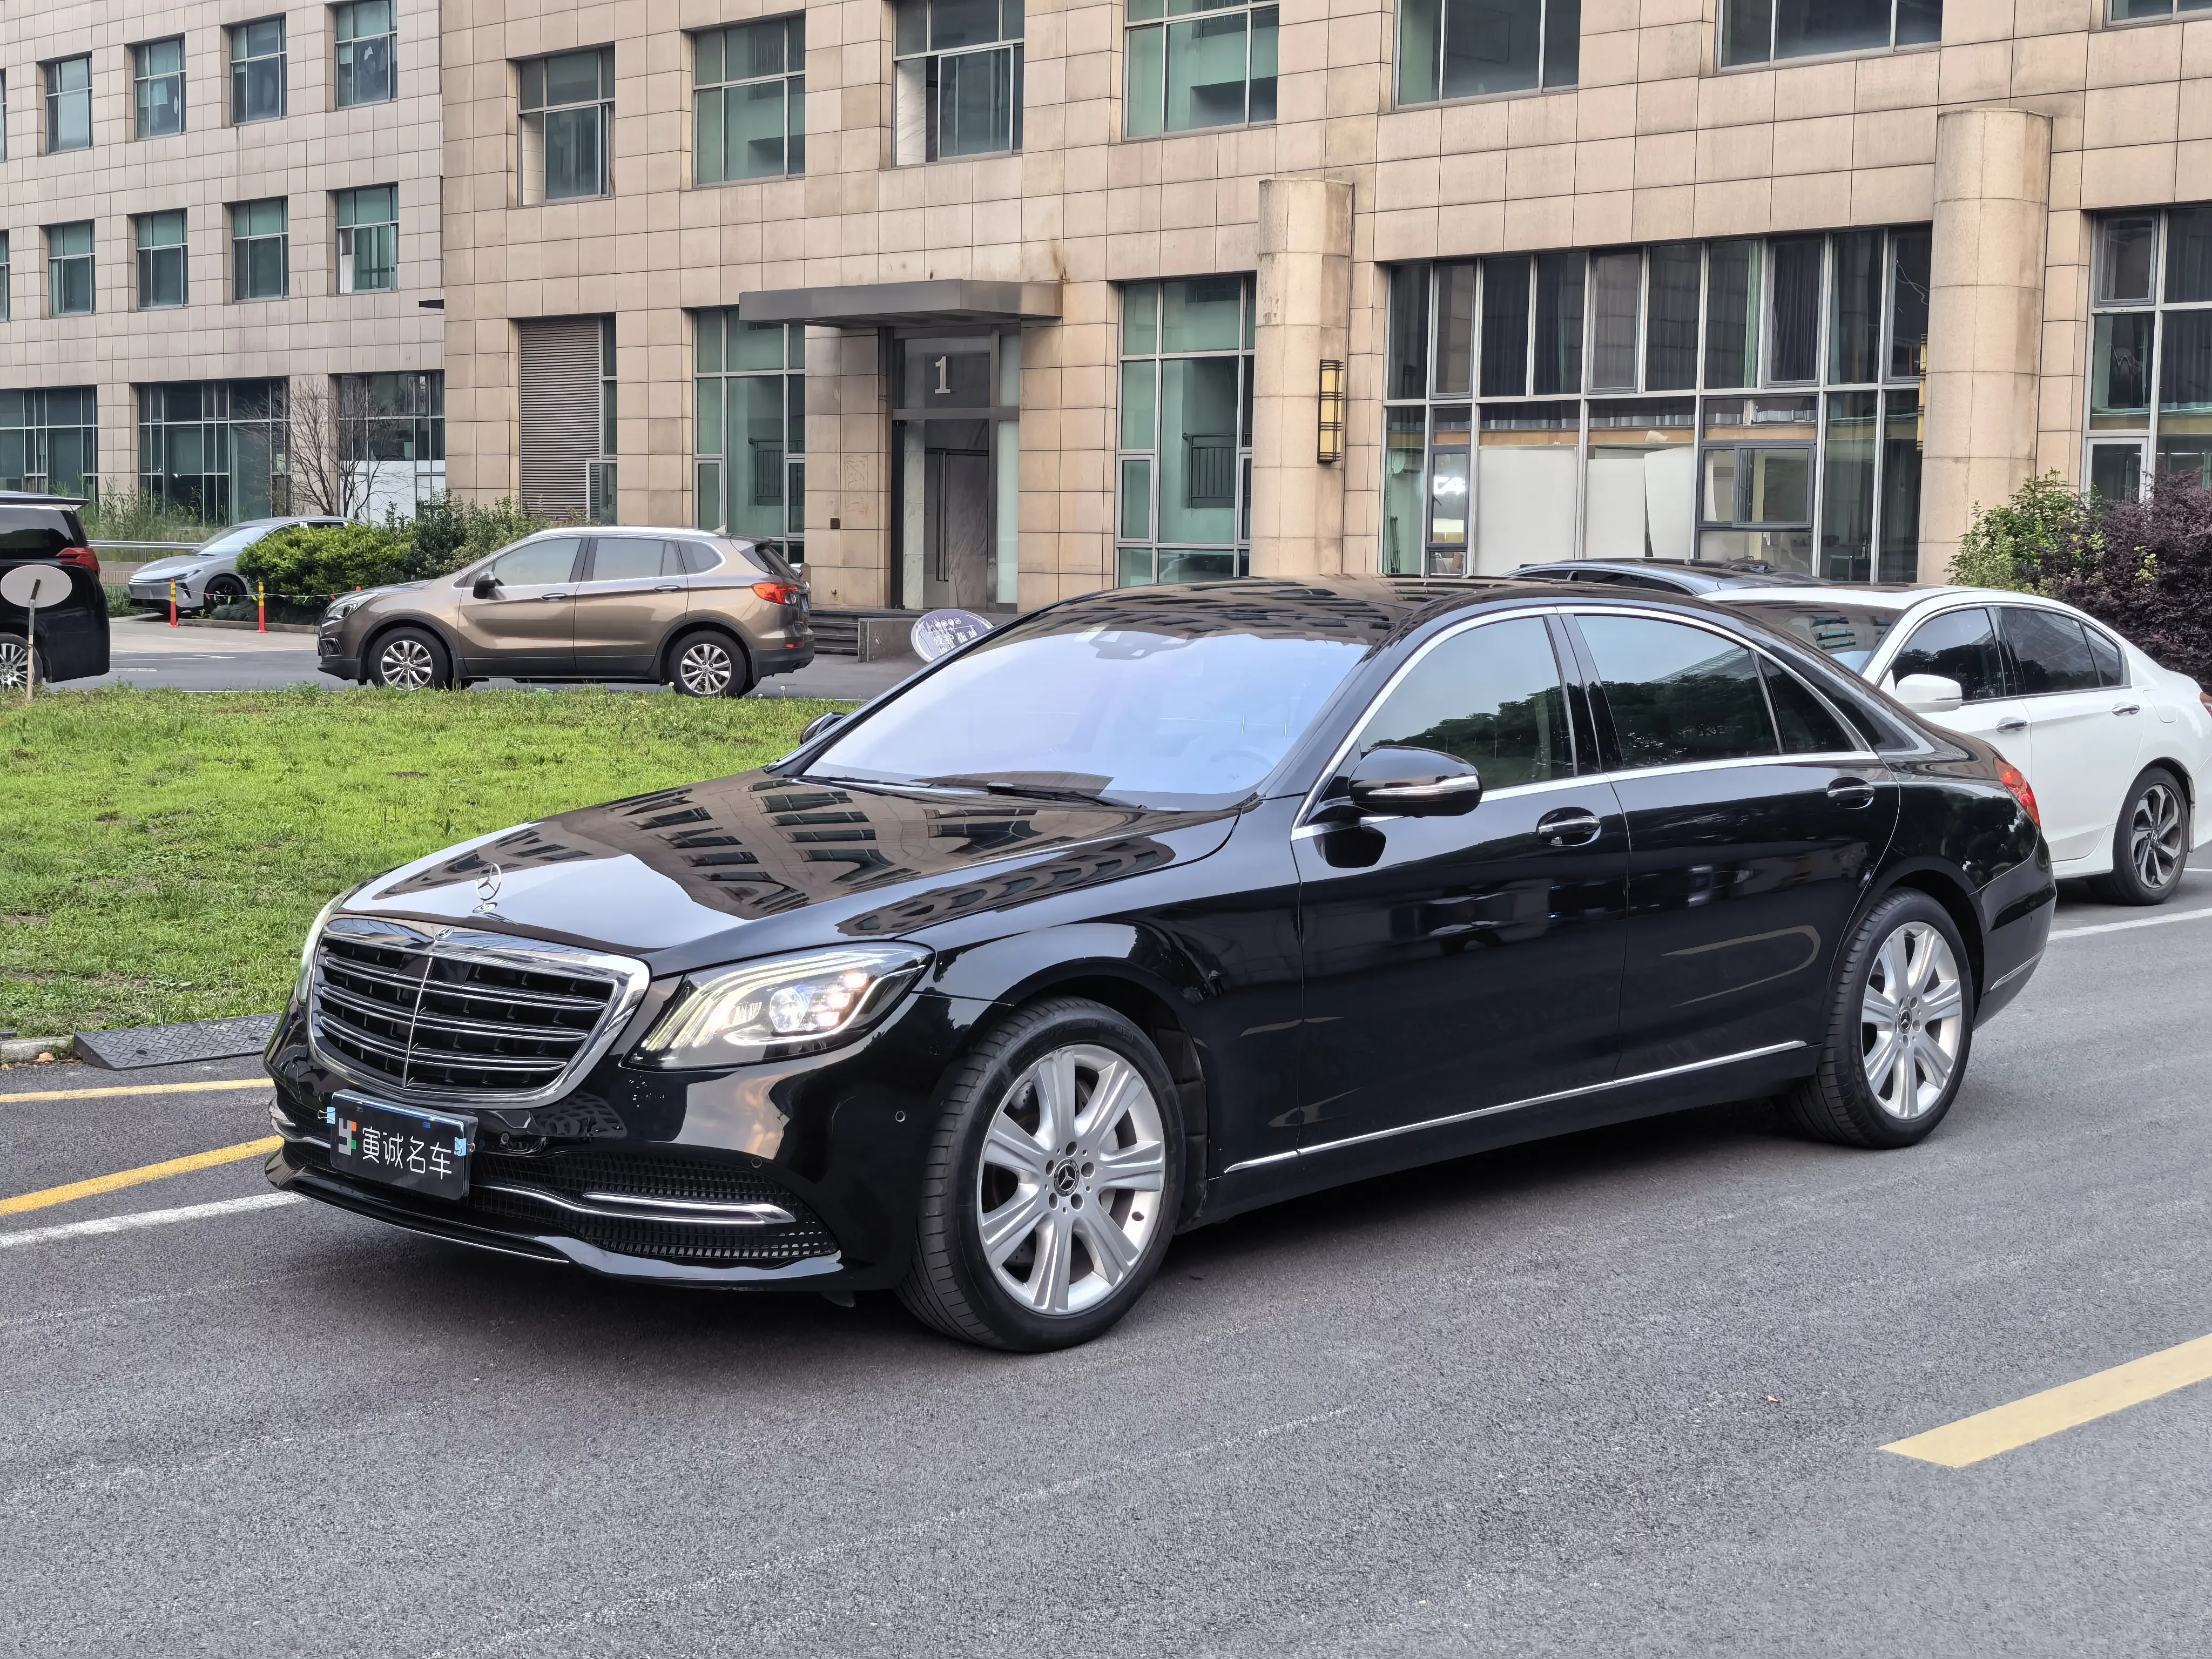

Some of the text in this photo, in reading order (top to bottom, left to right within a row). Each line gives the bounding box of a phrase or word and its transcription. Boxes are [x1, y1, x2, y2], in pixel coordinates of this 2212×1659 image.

[935, 355, 950, 394] 1
[362, 1126, 452, 1179] 寅诚名车
